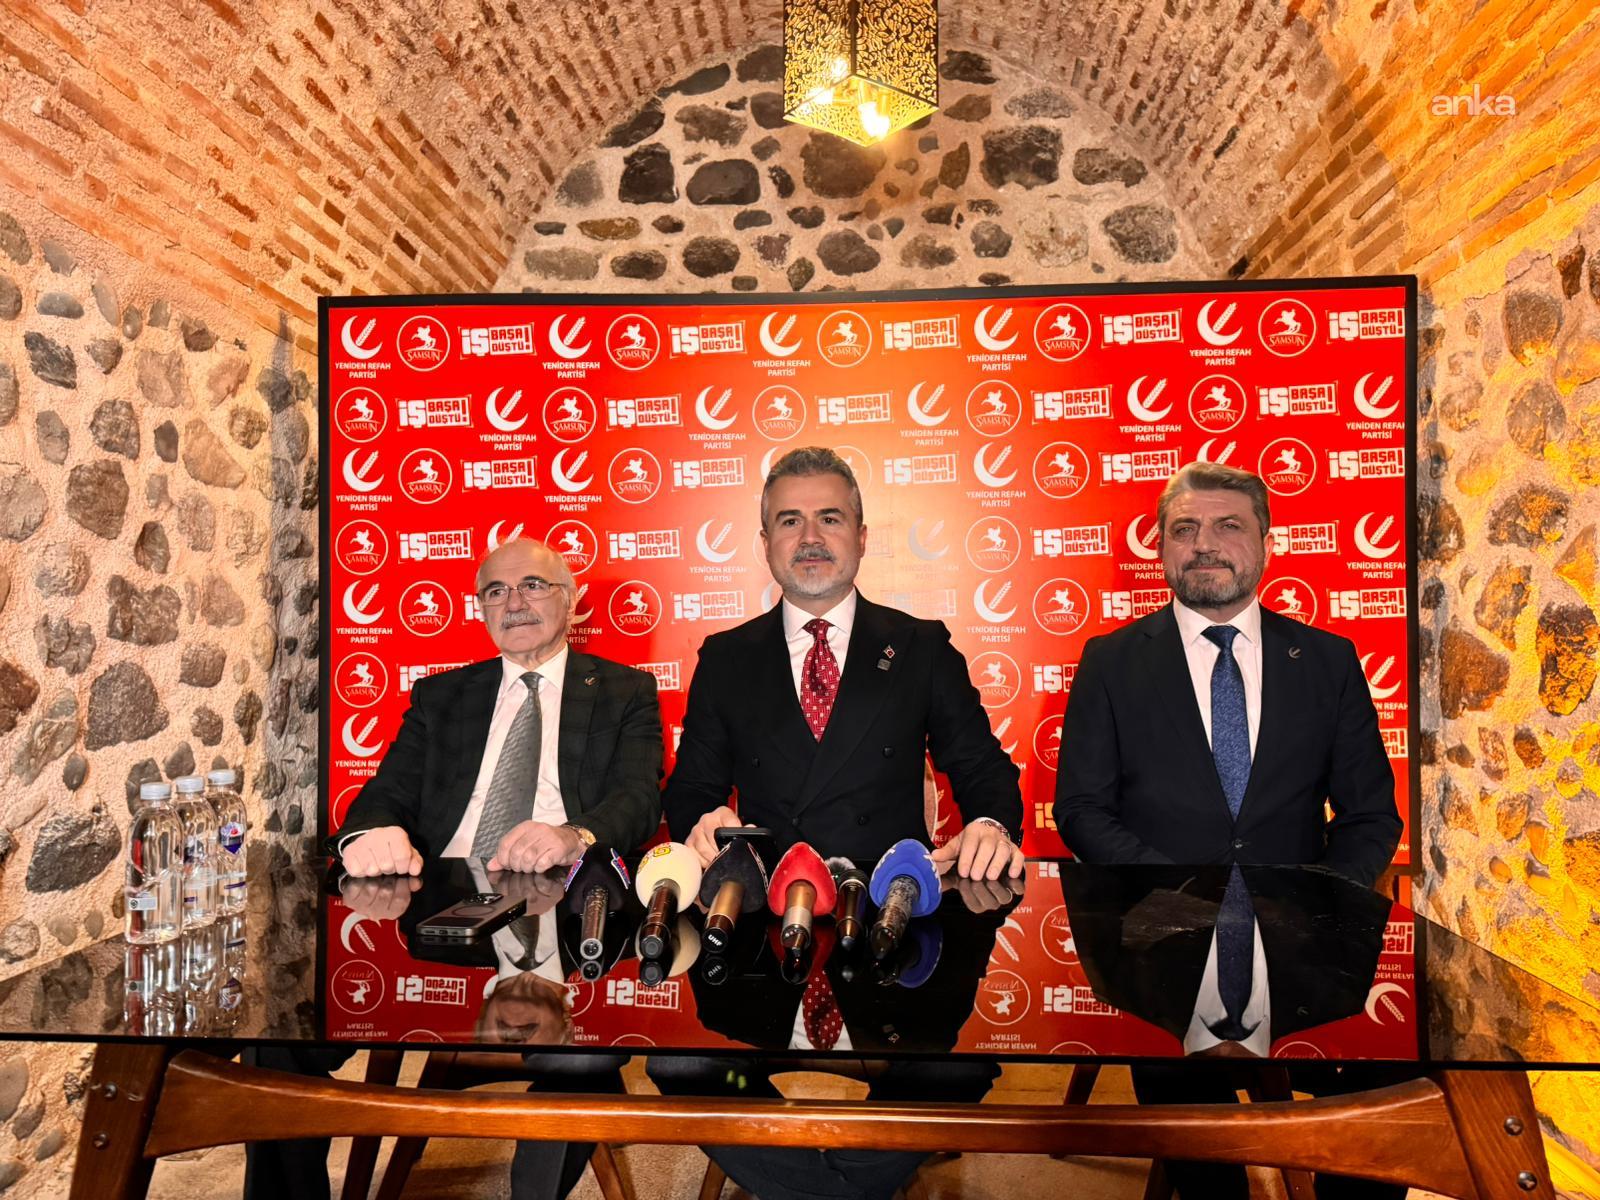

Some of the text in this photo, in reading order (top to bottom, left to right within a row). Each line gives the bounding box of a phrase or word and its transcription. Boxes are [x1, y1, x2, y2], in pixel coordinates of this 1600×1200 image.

[1135, 316, 1167, 328] BAŞA
[1362, 313, 1394, 324] BAŞA
[702, 326, 732, 338] BAŞA
[914, 323, 946, 334] BAŞA
[492, 329, 523, 341] BAŞA
[1269, 334, 1305, 346] SAMSUN
[827, 346, 861, 357] SAMSUN
[1045, 341, 1080, 352] SAMSUN
[407, 350, 441, 361] SAMSUN
[617, 349, 650, 360] SAMSUN
[968, 354, 1000, 362] YENİDEN
[982, 362, 1010, 370] PARTİSİ
[558, 370, 585, 378] PARTİSİ
[768, 368, 795, 376] PARTİSİ
[1066, 392, 1099, 404] BAŞA
[1291, 387, 1323, 399] BAŞA
[428, 401, 460, 412] BAŞA
[637, 400, 669, 412] BAŞA
[848, 397, 879, 409] BAŞA
[976, 415, 1010, 427] SAMSUN
[1199, 411, 1235, 423] SAMSUN
[345, 422, 377, 433] SAMSUN
[554, 422, 586, 433] SAMSUN
[762, 420, 795, 432] SAMSUN
[494, 442, 522, 450] PARTİSİ
[914, 458, 944, 469] BAŞA
[1134, 454, 1168, 466] BAŞA
[1361, 452, 1394, 464] BAŞA
[493, 462, 525, 473] BAŞA
[704, 461, 734, 472] BAŞA
[1043, 479, 1078, 488] SAMSUN
[1269, 473, 1305, 486] SAMSUN
[409, 484, 442, 494] SAMSUN
[618, 483, 652, 494] SAMSUN
[1065, 529, 1098, 541] BAŞA
[1291, 527, 1325, 539] BAŞA
[429, 533, 461, 545] BAŞA
[639, 534, 670, 545] BAŞA
[345, 554, 378, 565] SAMSUN
[1134, 591, 1168, 603] BAŞA
[1362, 592, 1396, 603] BAŞA
[409, 616, 442, 626] SAMSUN
[619, 616, 652, 626] SAMSUN
[1043, 615, 1079, 625] SAMSUN
[344, 686, 377, 698] SAMSUN
[349, 769, 376, 777] PARTİSİ
[708, 934, 722, 946] UHF
